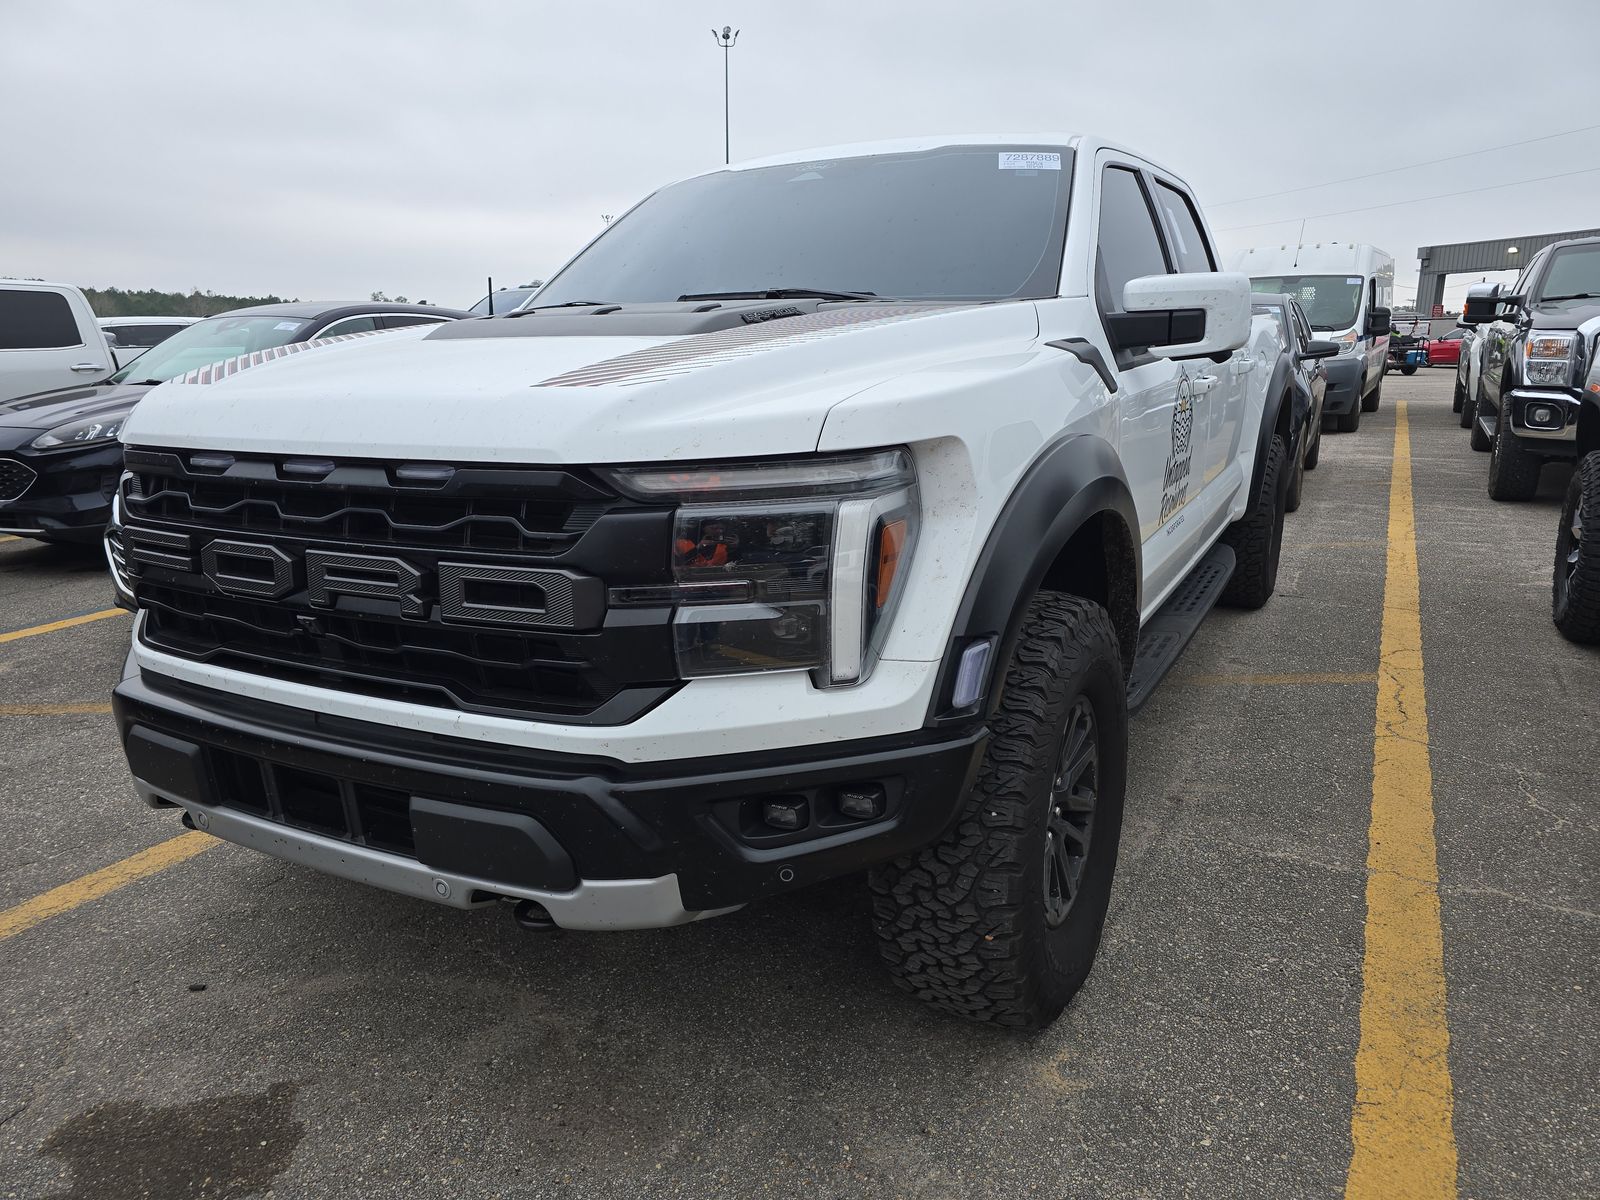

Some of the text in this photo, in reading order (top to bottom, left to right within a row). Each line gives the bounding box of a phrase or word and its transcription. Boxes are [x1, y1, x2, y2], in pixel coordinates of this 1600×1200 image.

[1005, 153, 1060, 161] 7287889
[742, 306, 801, 323] RAPTOR
[122, 524, 602, 635] FORD
